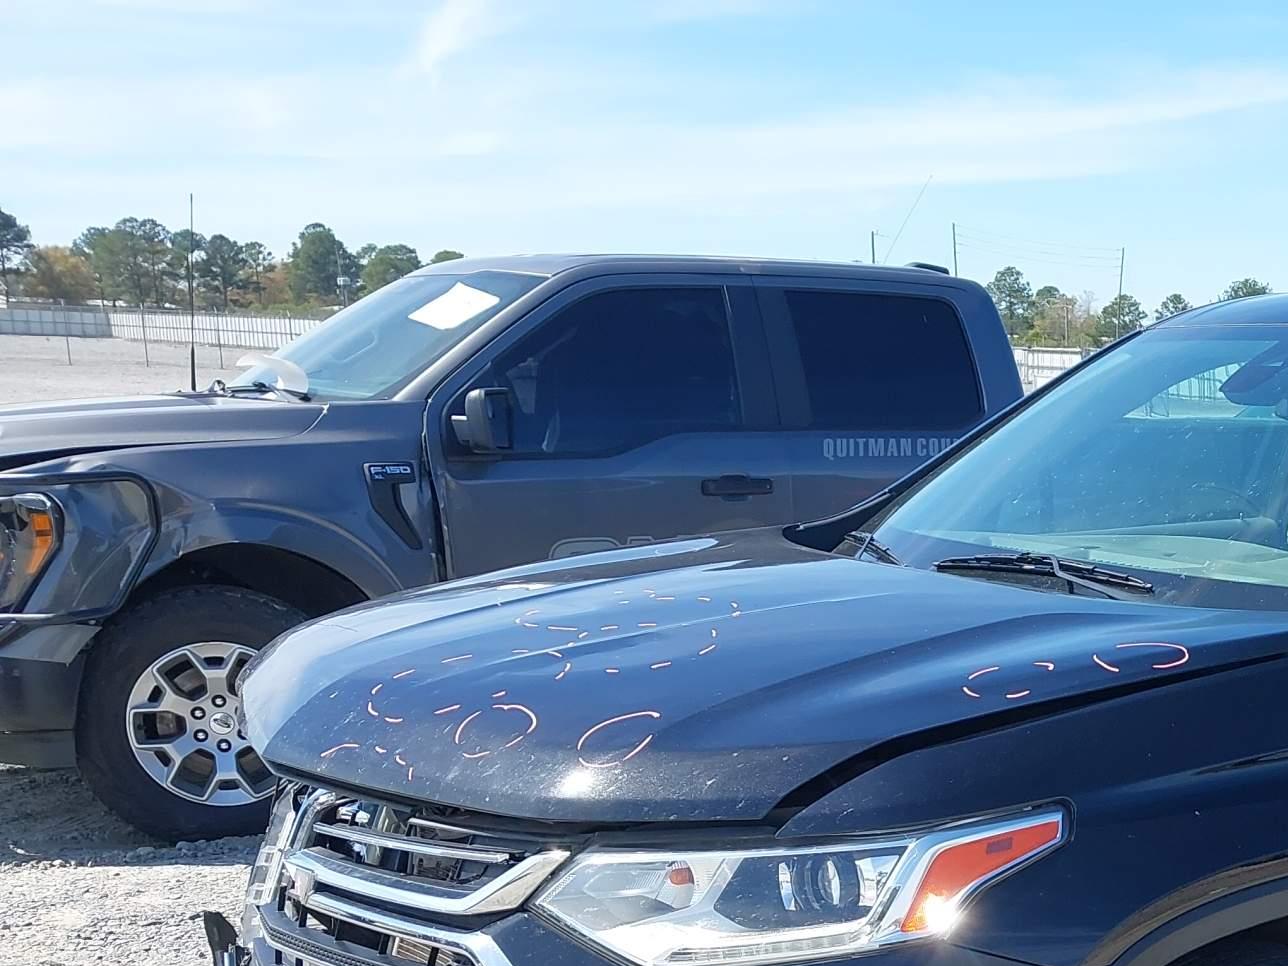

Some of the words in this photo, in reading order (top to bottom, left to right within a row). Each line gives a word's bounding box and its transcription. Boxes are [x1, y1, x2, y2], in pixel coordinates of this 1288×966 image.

[823, 438, 912, 460] QUITMAN
[916, 438, 960, 457] COU
[370, 466, 411, 474] F-150
